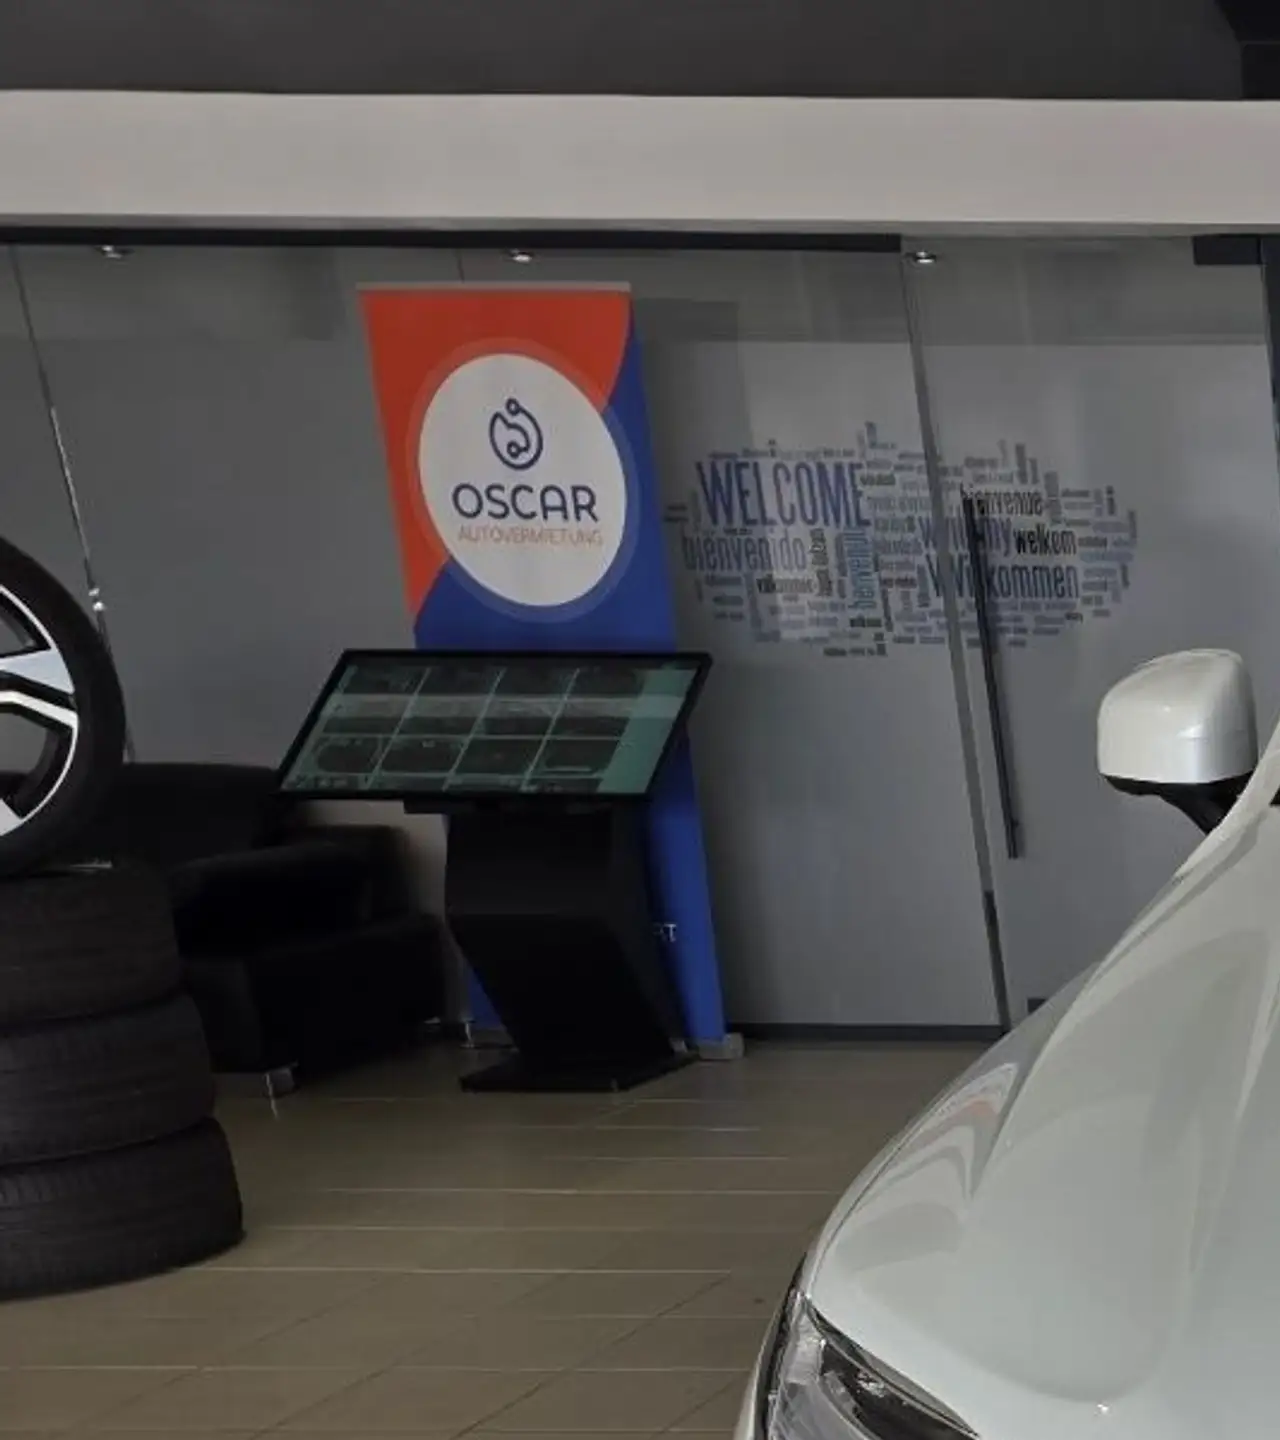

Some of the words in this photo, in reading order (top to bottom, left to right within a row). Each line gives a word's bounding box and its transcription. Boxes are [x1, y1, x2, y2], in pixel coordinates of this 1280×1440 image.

[452, 483, 598, 523] OSCAR
[695, 460, 871, 528] WELCOME
[458, 524, 603, 547] AUTOVERMIETUNG
[682, 525, 807, 572] bienvenido
